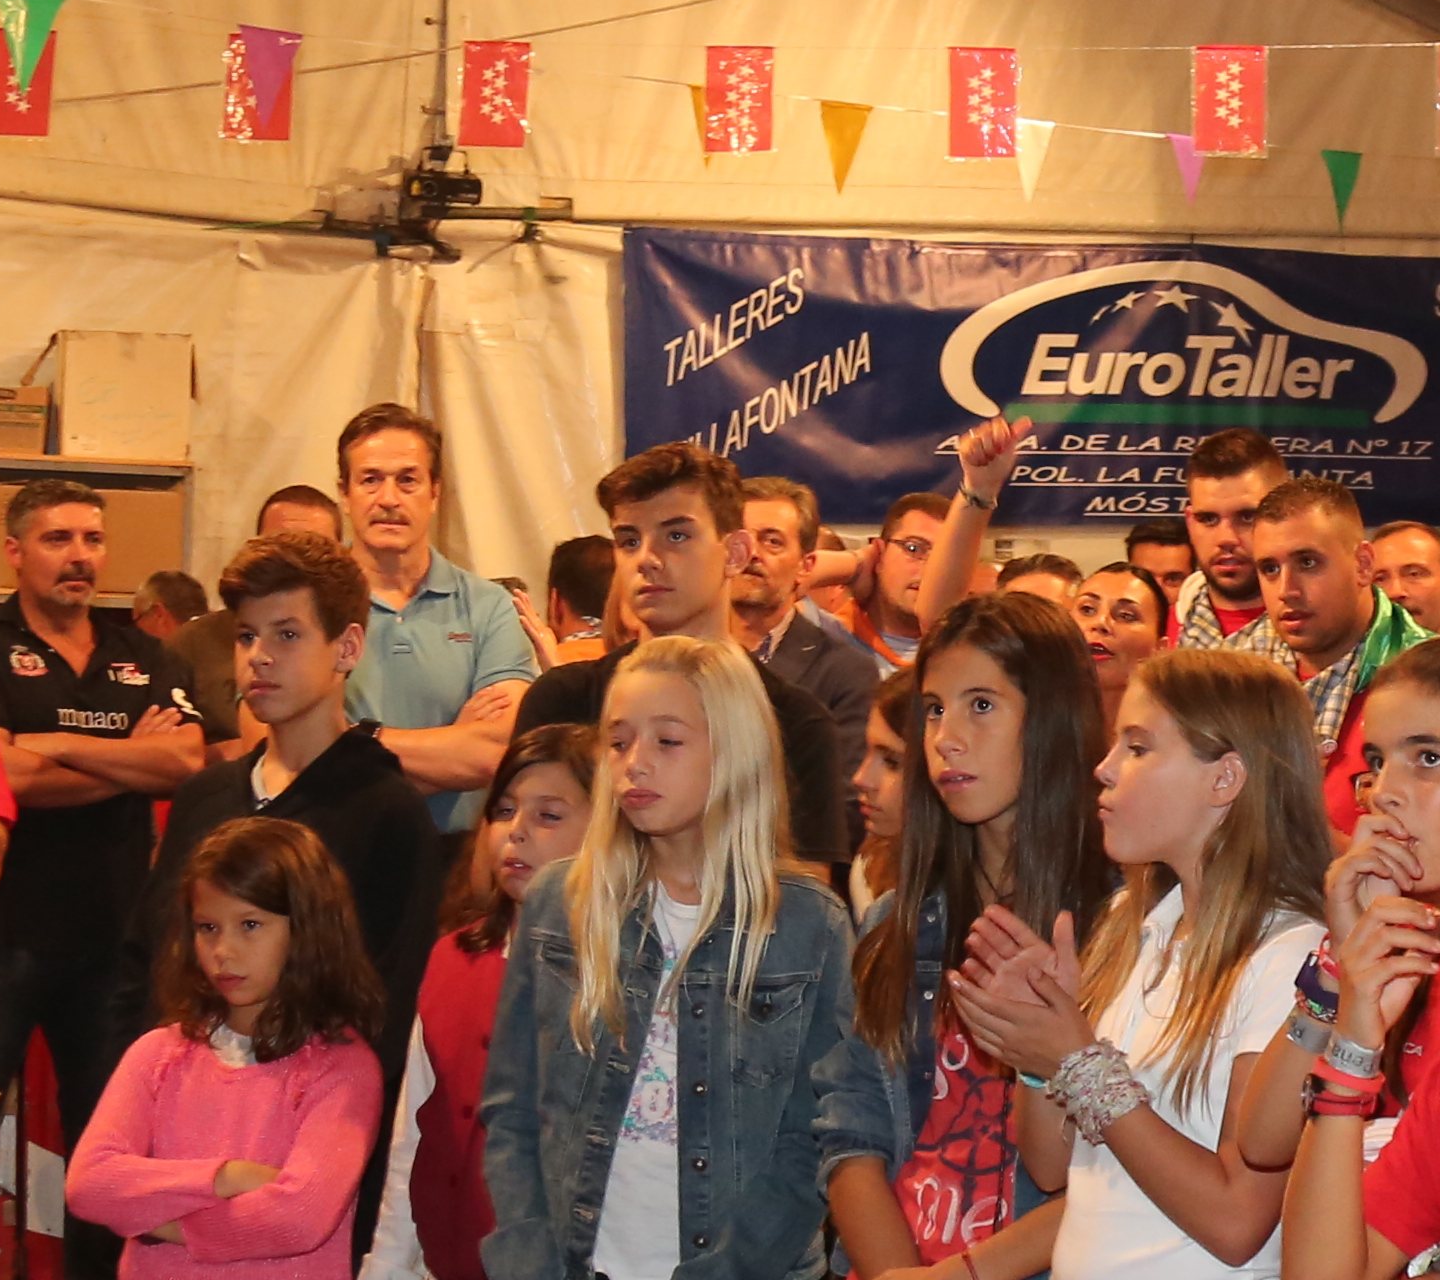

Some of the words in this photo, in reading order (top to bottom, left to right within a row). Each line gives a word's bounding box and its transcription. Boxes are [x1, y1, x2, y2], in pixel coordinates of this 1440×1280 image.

[663, 268, 805, 387] TALLERES
[680, 331, 871, 458] LAFONTANA
[1021, 334, 1354, 399] EuroTaller
[937, 434, 1047, 450] AA.
[1060, 434, 1109, 451] DE
[1117, 435, 1161, 451] LA
[1173, 435, 1334, 453] RERA
[1400, 440, 1433, 456] 17
[1012, 465, 1084, 483] POL.
[1097, 466, 1140, 483] LA
